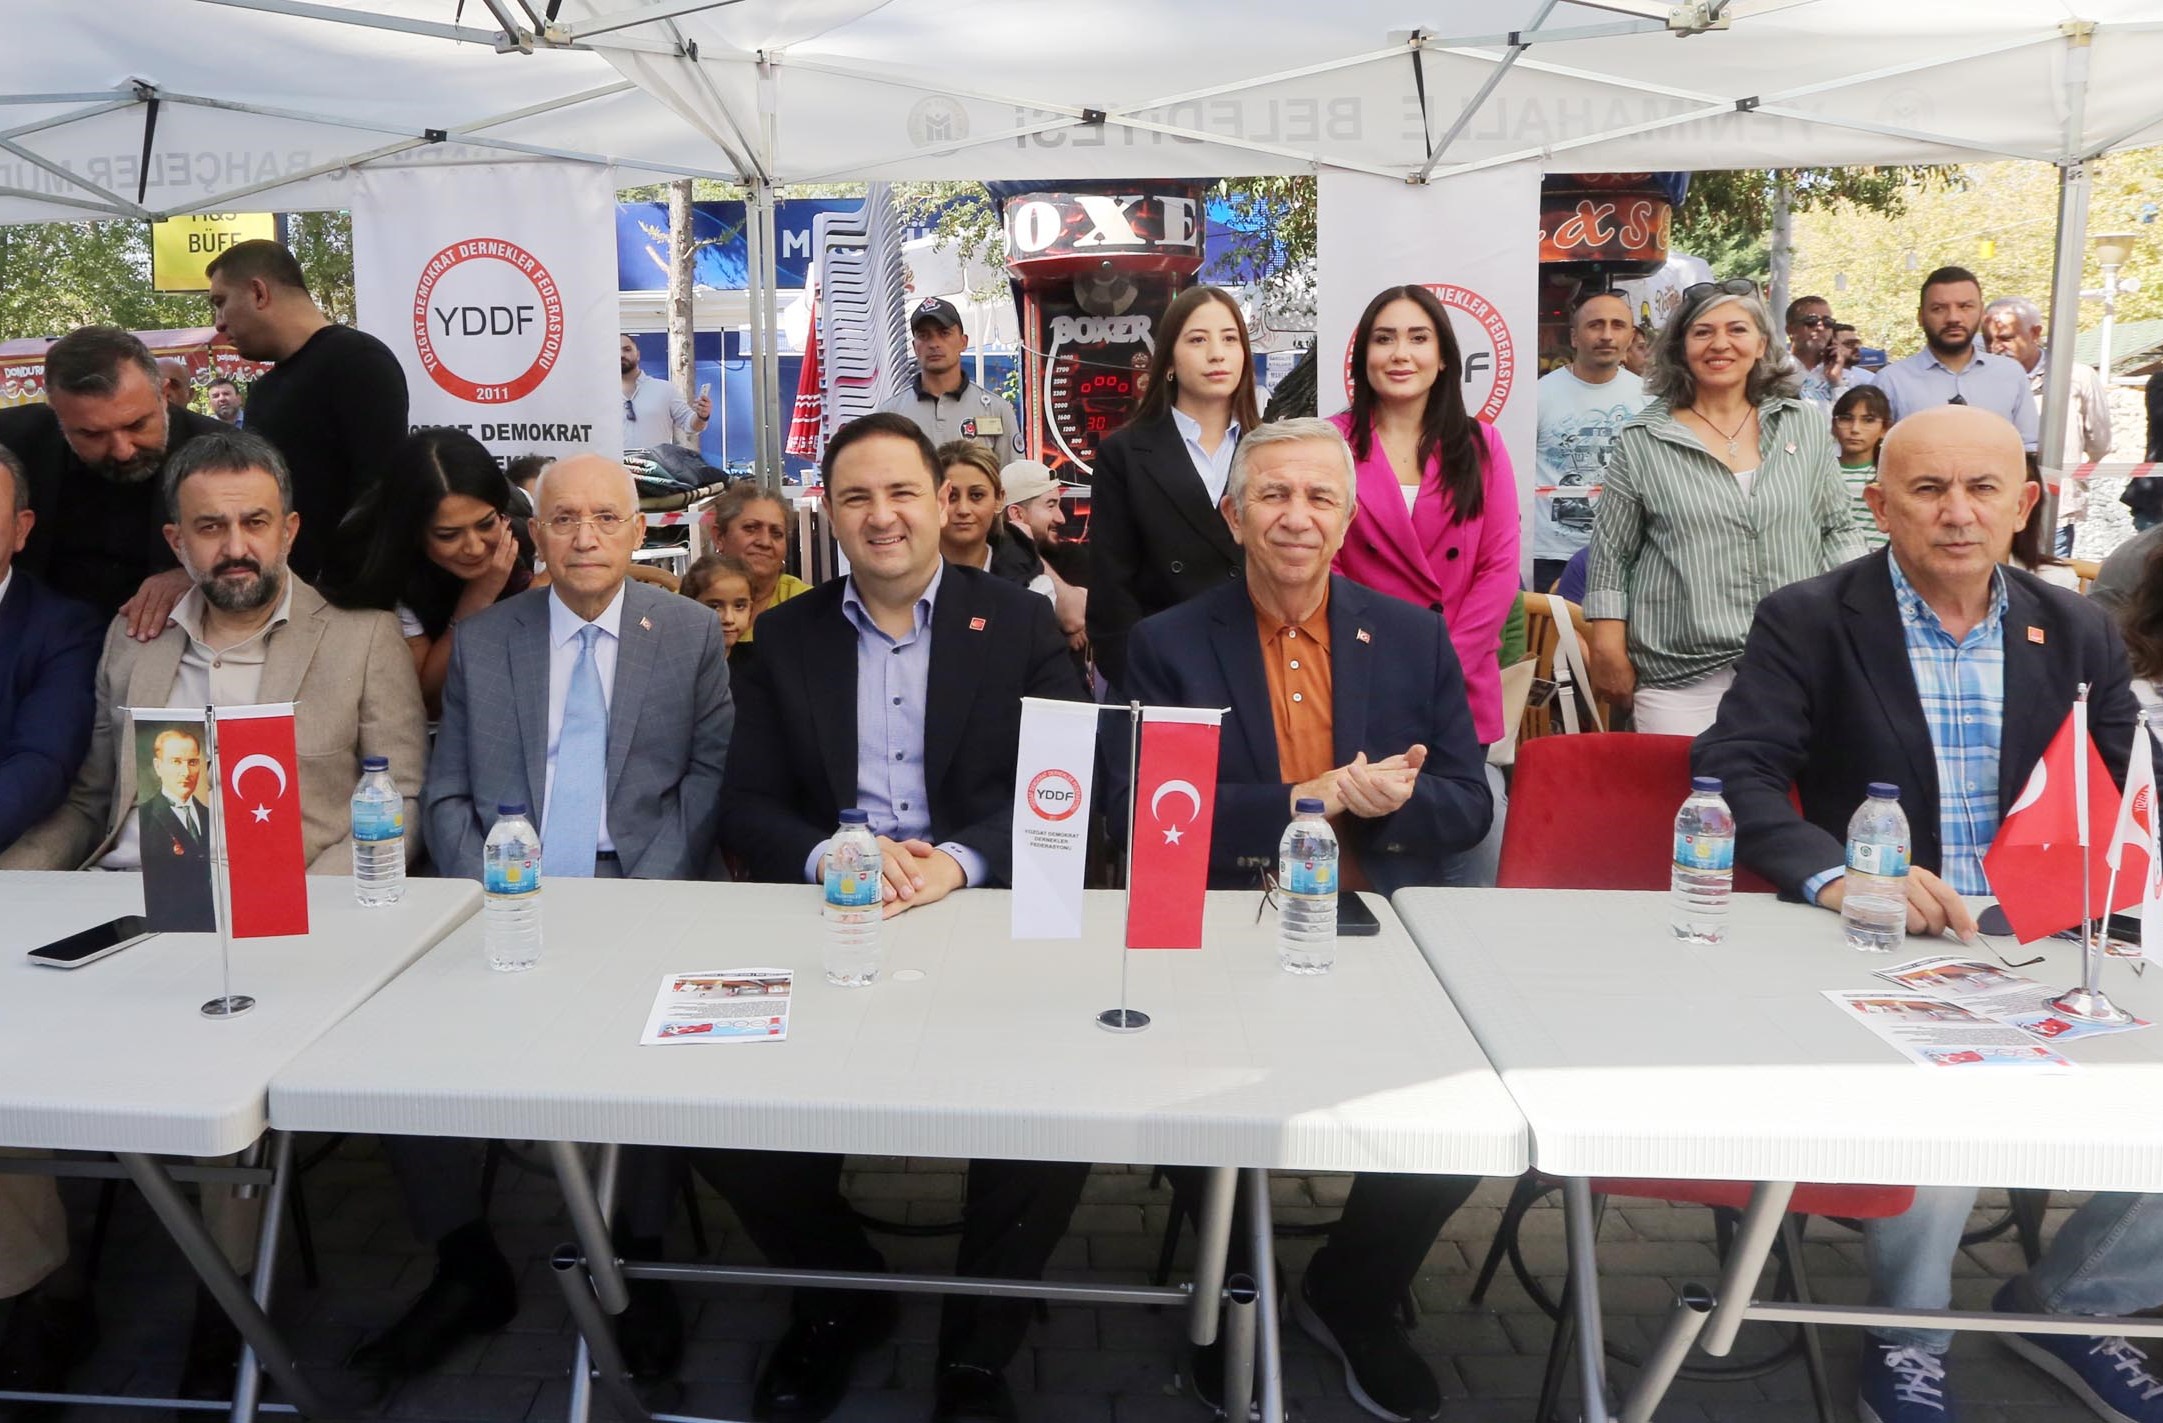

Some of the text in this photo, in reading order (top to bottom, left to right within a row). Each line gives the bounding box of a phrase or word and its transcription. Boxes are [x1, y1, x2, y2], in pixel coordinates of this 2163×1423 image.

[1004, 195, 1198, 253] OXE
[415, 241, 562, 372] YOZGAT DEMOKRAT DERNEKLER FEDERASYONU
[434, 305, 535, 337] YDDF
[1426, 287, 1489, 318] NEKLER
[1485, 313, 1512, 419] FEDERASYONU
[476, 387, 510, 400] 2011
[481, 424, 592, 442] DEMOKRAT
[1036, 789, 1074, 801] YDDF
